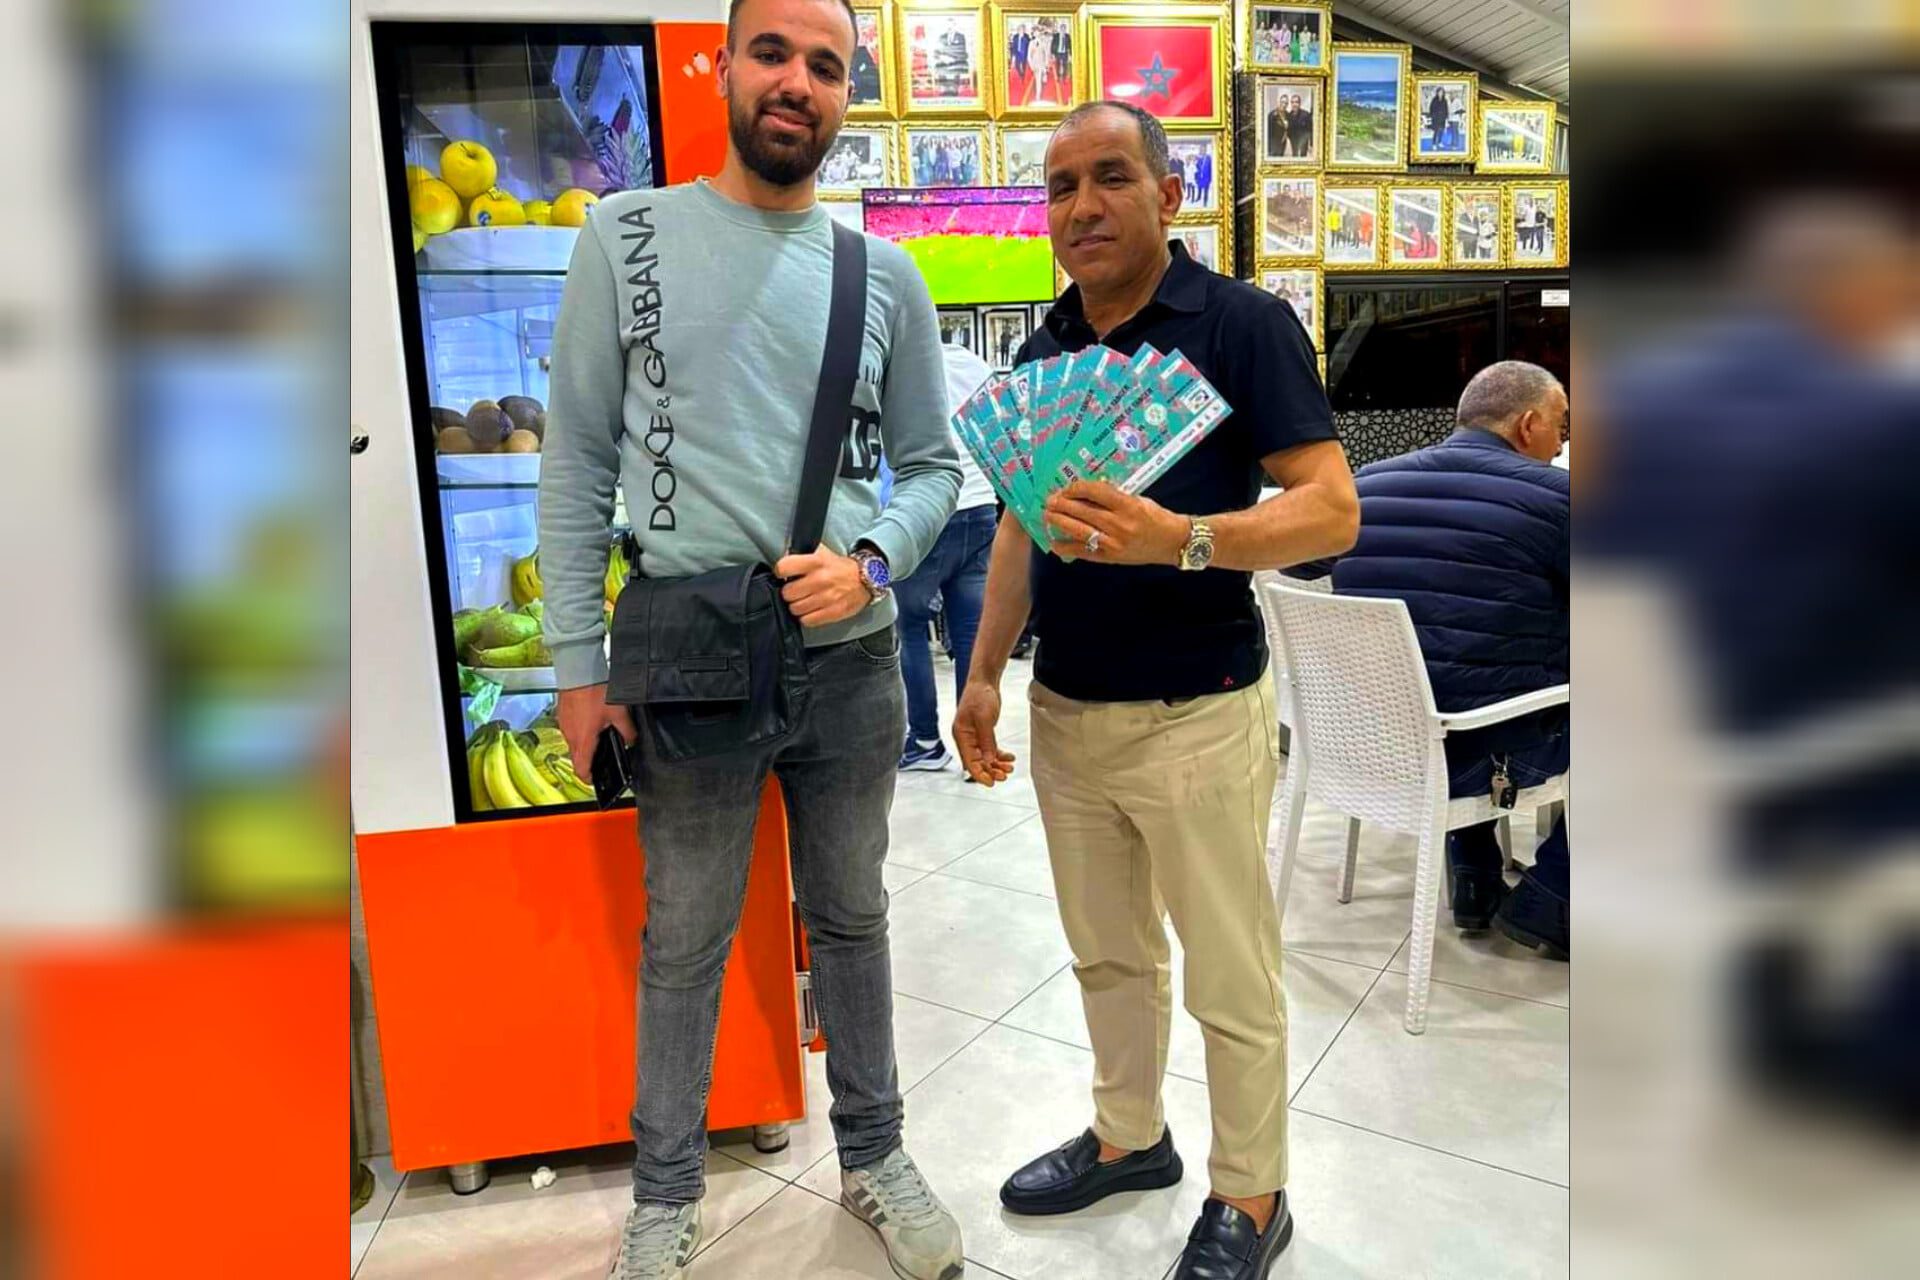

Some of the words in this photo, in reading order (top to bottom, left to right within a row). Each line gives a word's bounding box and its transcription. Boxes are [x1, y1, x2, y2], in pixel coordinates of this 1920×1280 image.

[617, 206, 667, 389] GABBANA
[656, 395, 672, 409] &
[1109, 413, 1126, 430] STADE
[1132, 386, 1153, 407] TANGER
[644, 415, 677, 531] DOLCE
